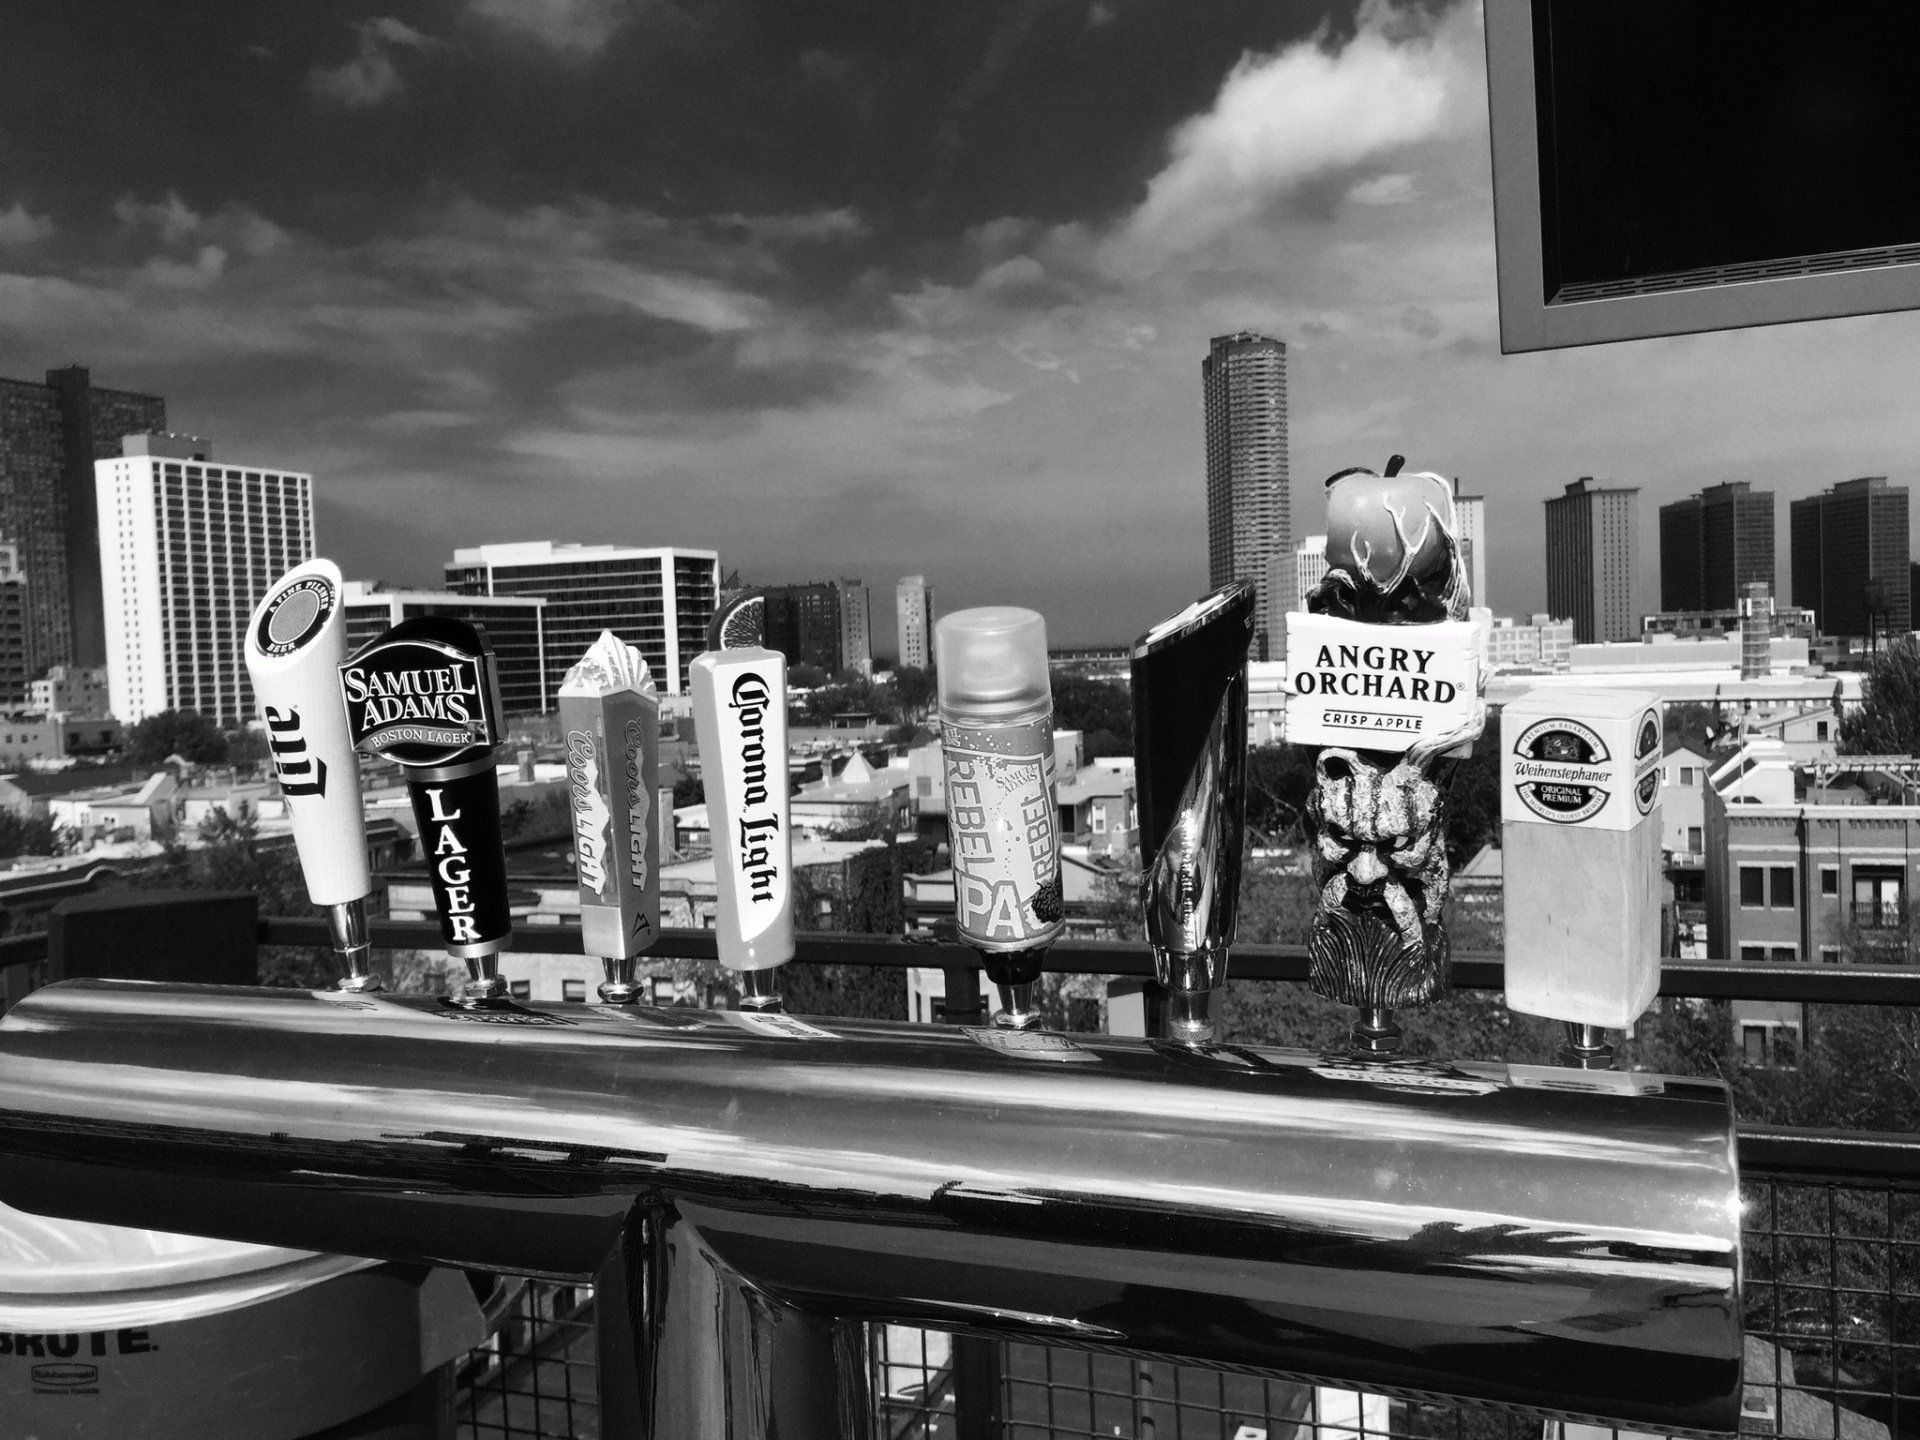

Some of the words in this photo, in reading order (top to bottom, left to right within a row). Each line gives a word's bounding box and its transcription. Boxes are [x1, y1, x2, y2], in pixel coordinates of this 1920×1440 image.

[268, 605, 277, 614] A
[276, 583, 303, 603] FINE
[305, 581, 329, 611] PILSNER
[266, 642, 296, 654] BEER
[1315, 645, 1435, 674] ANGRY
[344, 664, 476, 703] SAMUEL
[1295, 671, 1456, 704] ORCHARD
[361, 694, 470, 731] ADAMS
[1323, 713, 1368, 726] CRISP
[1375, 717, 1423, 730] APPLE
[371, 728, 423, 748] BOSTON
[428, 731, 470, 744] LAGER
[729, 672, 770, 807] Corona
[1523, 723, 1556, 744] PREMIUM
[1558, 723, 1600, 748] BAVARICUM
[567, 730, 597, 813] Coors
[625, 717, 645, 808] Coors
[996, 764, 1038, 789] SAMUEL
[1514, 762, 1613, 782] Weihenstephaner
[1005, 773, 1038, 793] ADAMS
[1540, 785, 1582, 796] ORIGINAL
[1542, 793, 1582, 804] PREMIUM
[949, 757, 995, 876] REBEL
[1020, 781, 1054, 881] REBEL
[425, 789, 482, 941] LAGER
[575, 810, 606, 896] LIGHT
[629, 808, 645, 893] LIGHT
[739, 813, 779, 904] Light
